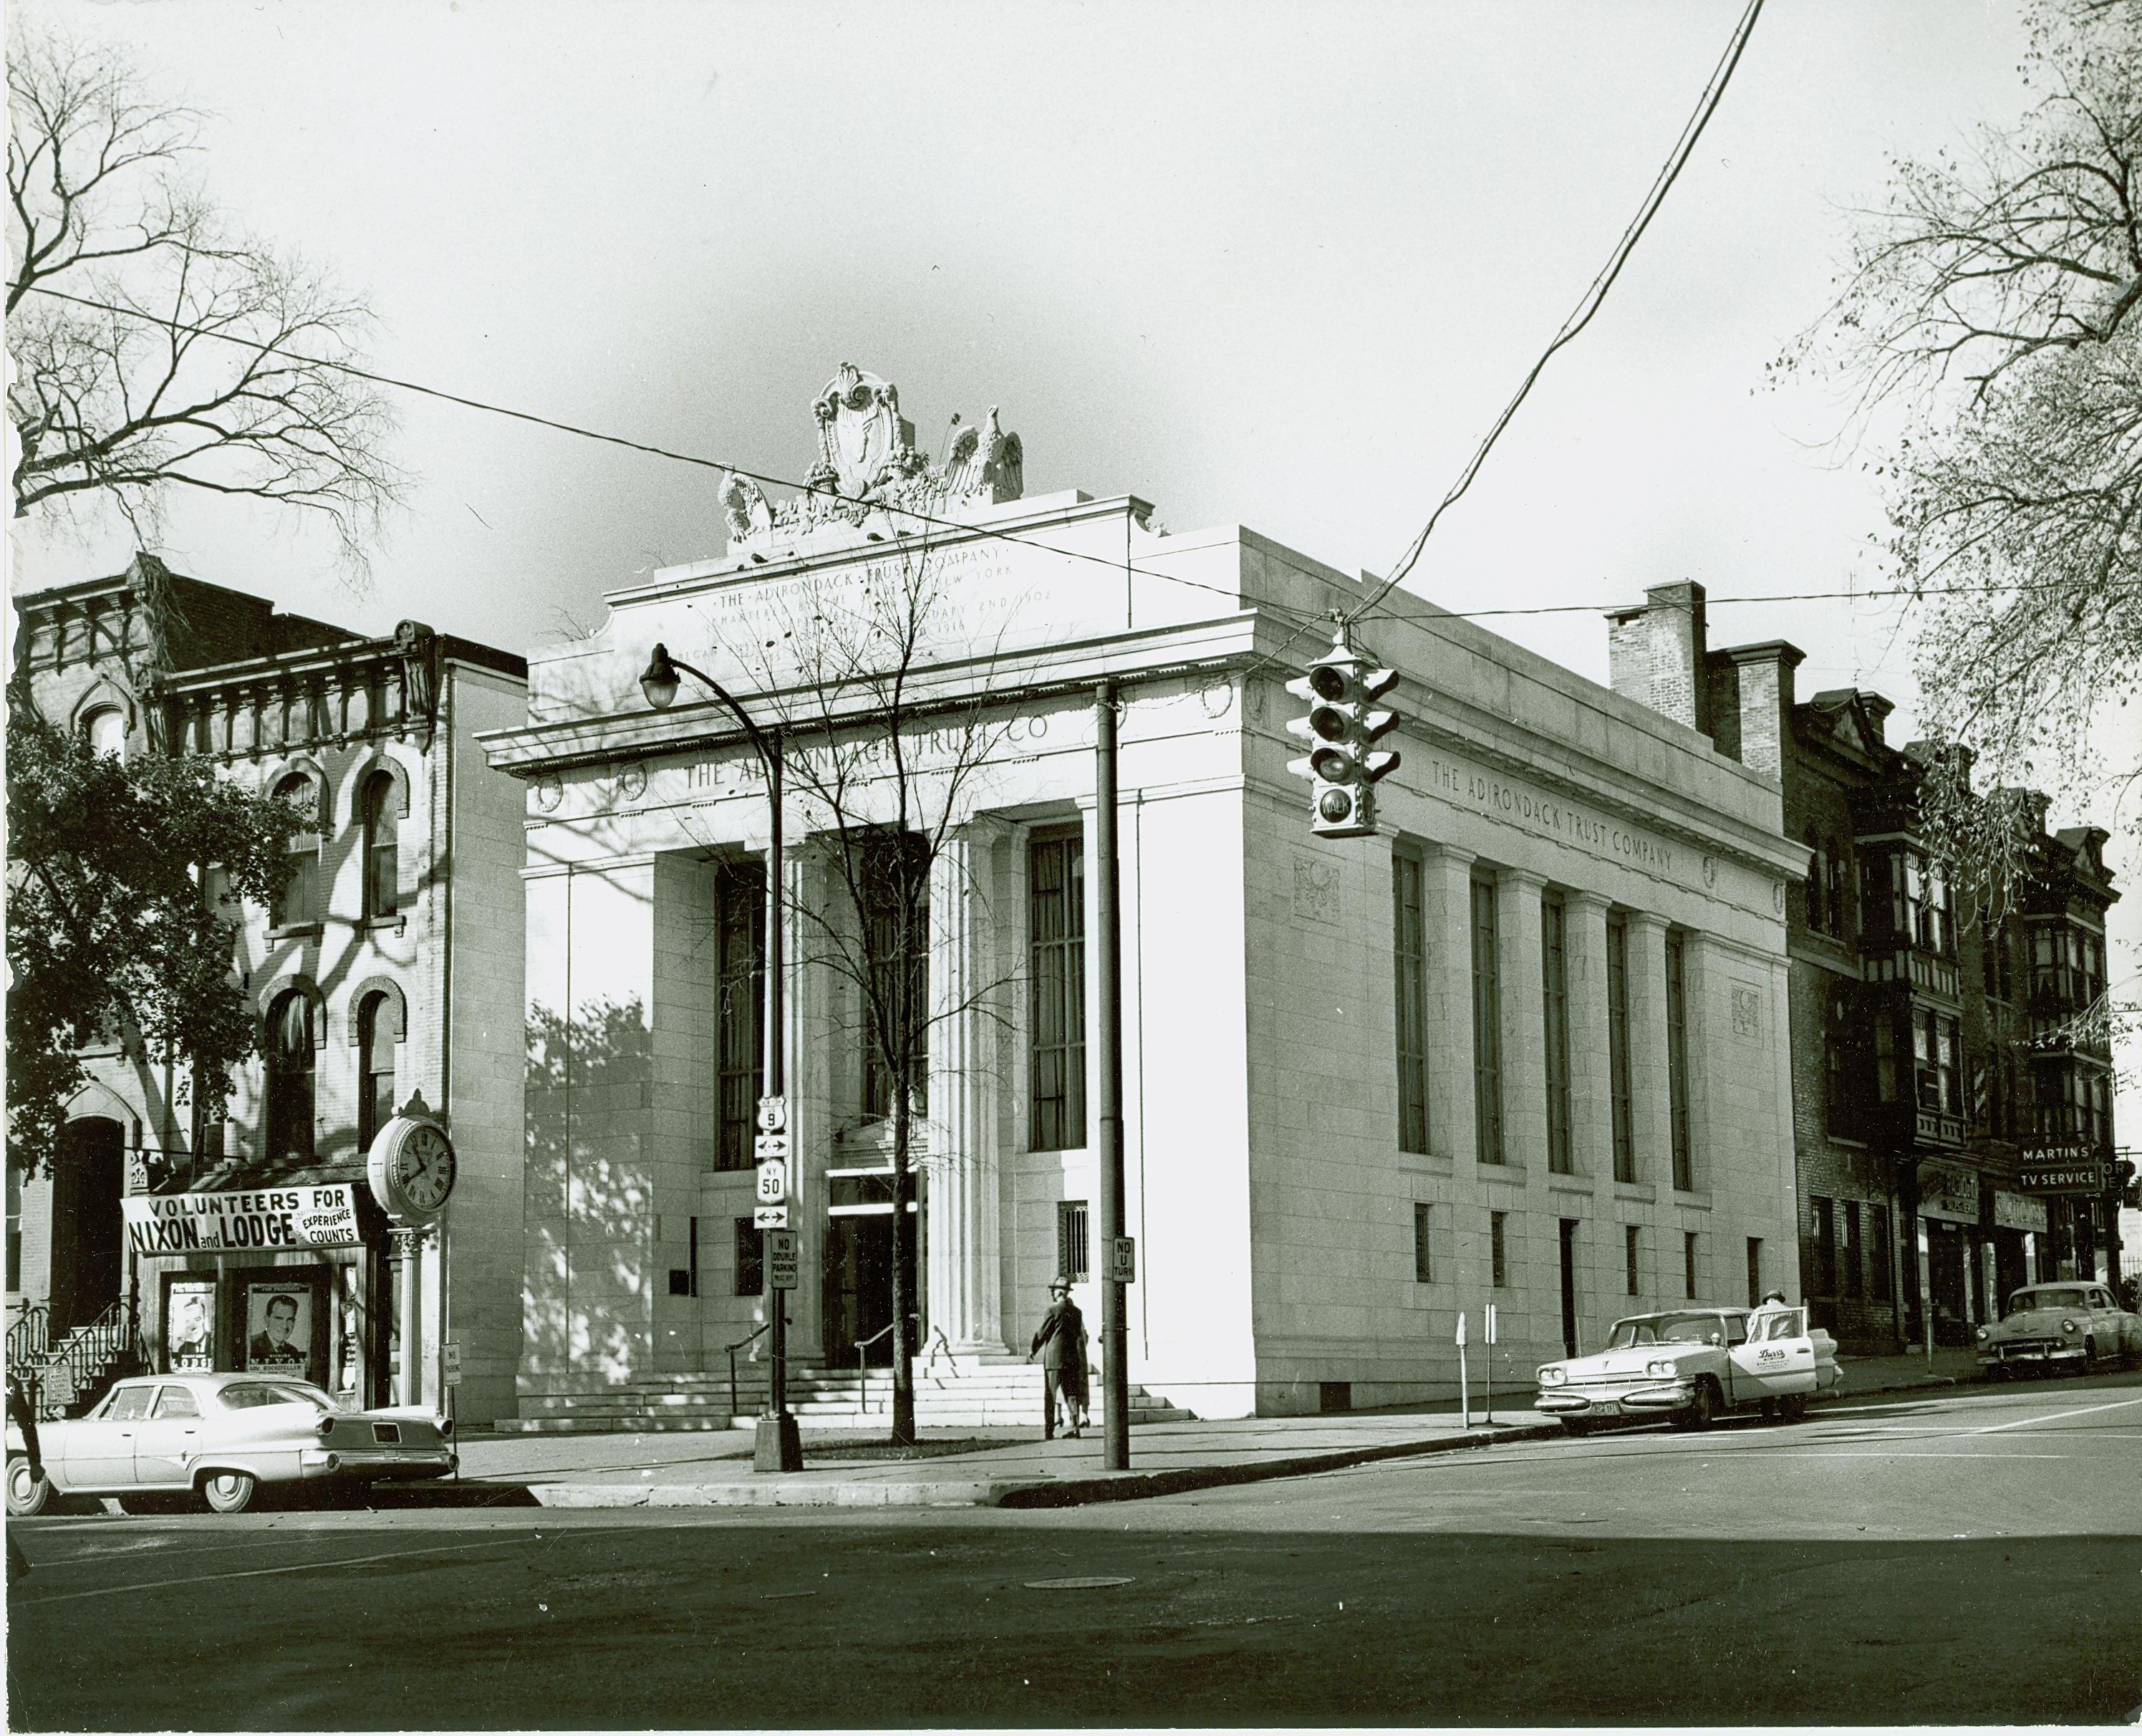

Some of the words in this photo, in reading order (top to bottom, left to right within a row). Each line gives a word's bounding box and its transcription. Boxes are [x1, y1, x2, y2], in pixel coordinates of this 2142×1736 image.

[975, 564, 1012, 580] YORK
[719, 592, 744, 609] THE
[865, 562, 908, 582] TRUS
[978, 596, 1007, 612] 2ND
[685, 761, 725, 789] THE
[740, 736, 897, 782] ADONDACK
[914, 722, 991, 756] TRUT
[1007, 715, 1048, 742] CO
[1322, 798, 1349, 814] WALK
[1432, 761, 1459, 791] THE
[1468, 775, 1560, 830] ADIRONDACK
[1567, 812, 1606, 847] TRUST
[1613, 831, 1671, 870] COMPANY
[768, 1113, 775, 1127] 9
[766, 1167, 777, 1176] NY
[2020, 1175, 2038, 1186] TV
[2041, 1171, 2095, 1186] SERVICE
[763, 1179, 779, 1195] 50
[148, 1192, 299, 1217] VOLUNTEERS
[313, 1190, 345, 1208] FOR
[302, 1208, 352, 1230] EXPERIENCE
[128, 1217, 200, 1252] NIXON
[201, 1230, 221, 1249] and
[219, 1212, 297, 1248] LODGE
[309, 1227, 354, 1243] COUNTS
[778, 1238, 790, 1250] NO
[1117, 1242, 1130, 1253] NO
[773, 1252, 796, 1261] DOUBLE
[1121, 1254, 1127, 1266] U
[772, 1263, 796, 1273] PARKING
[1114, 1267, 1134, 1276] TURN
[448, 1351, 455, 1359] NO
